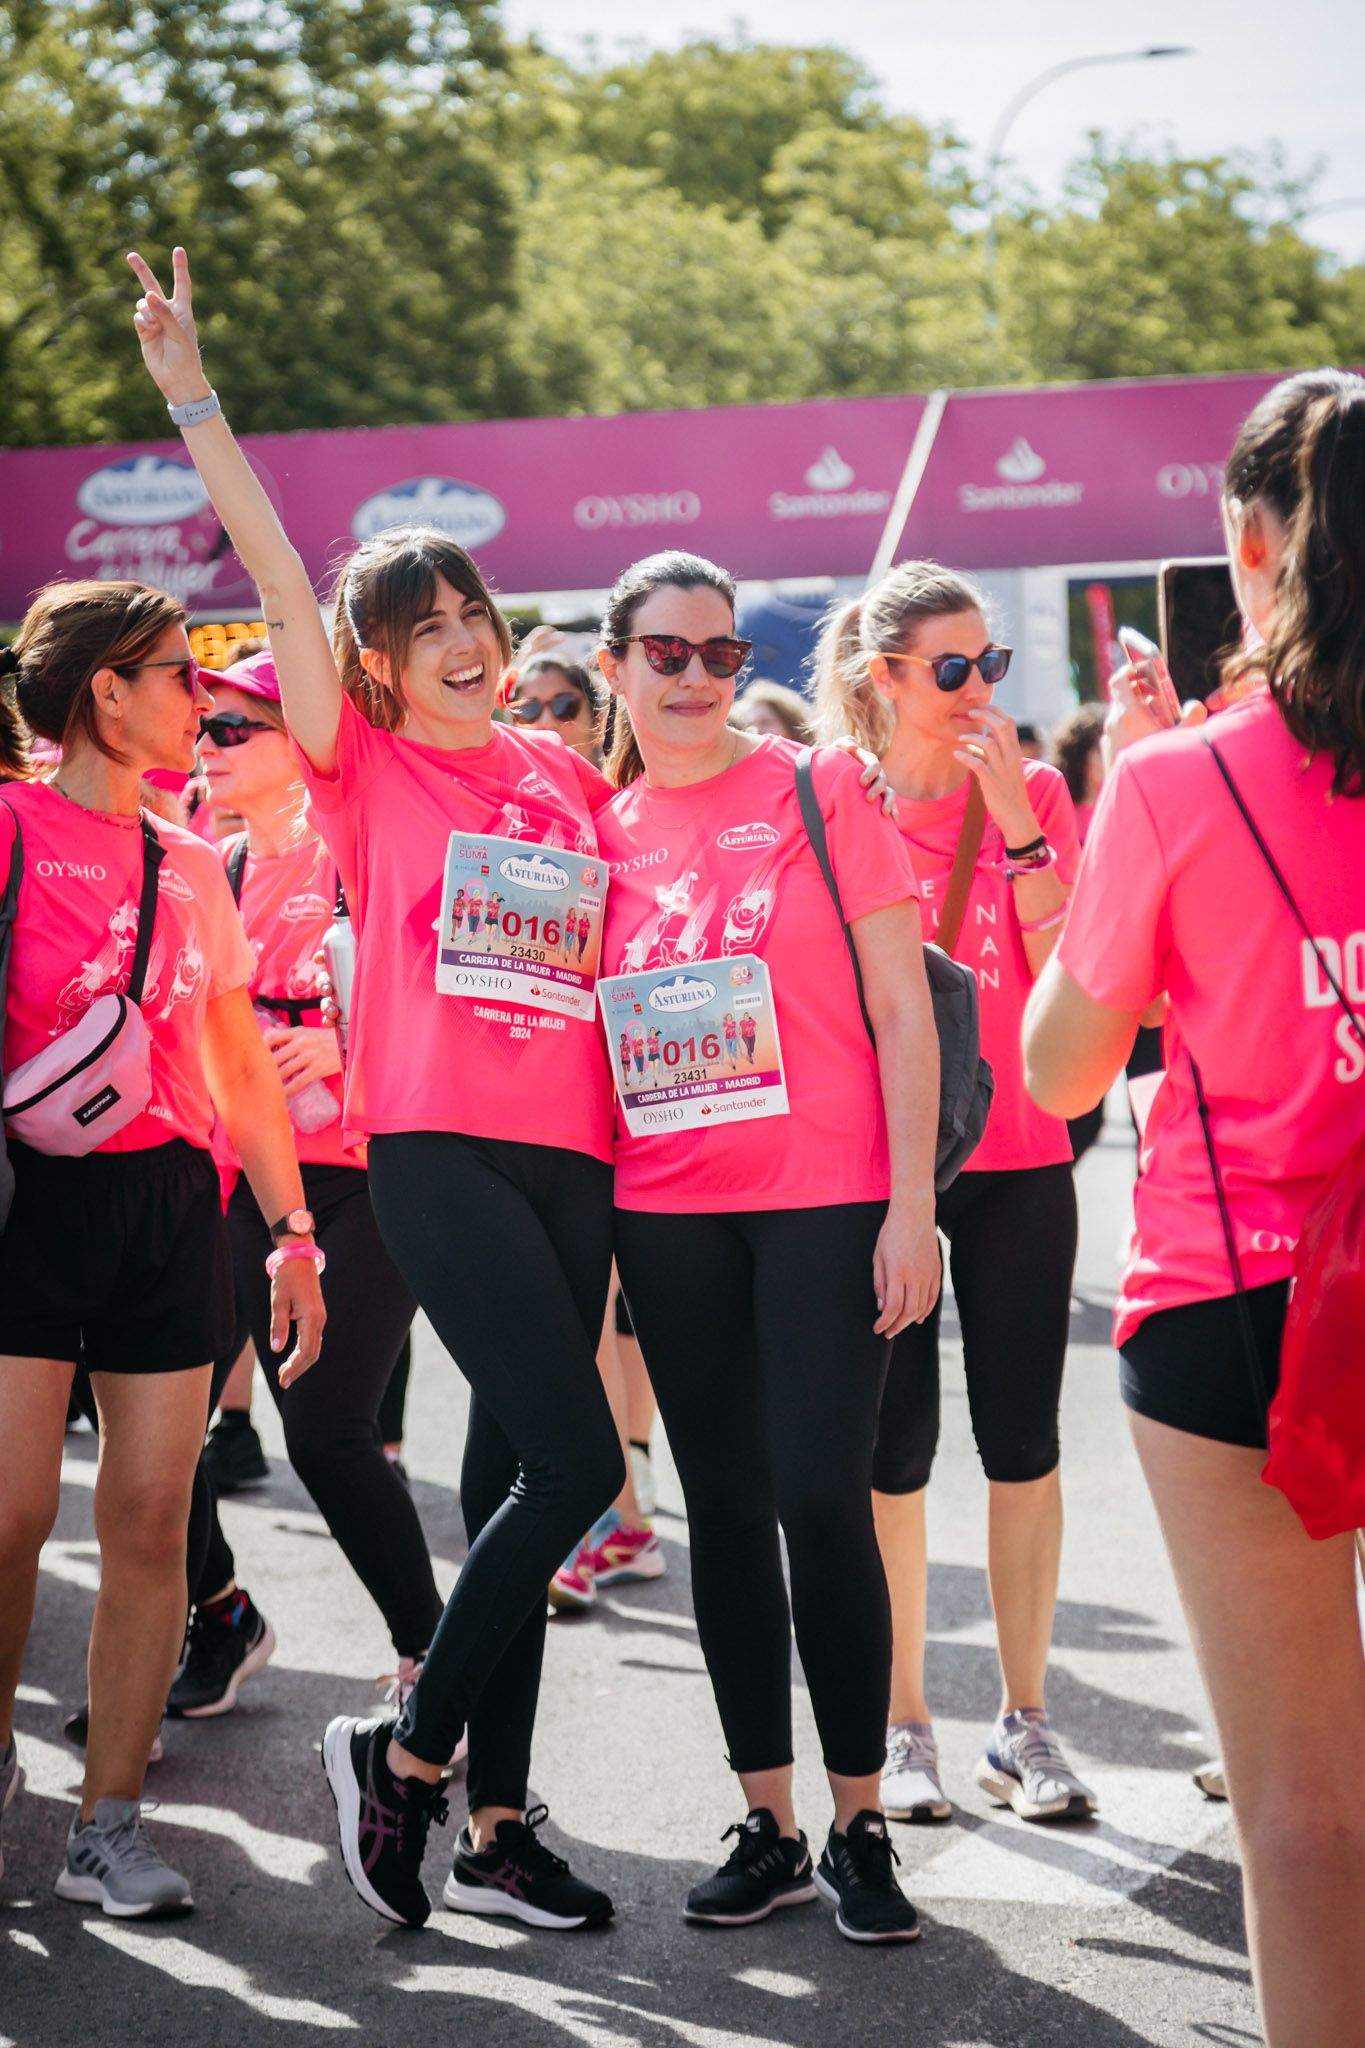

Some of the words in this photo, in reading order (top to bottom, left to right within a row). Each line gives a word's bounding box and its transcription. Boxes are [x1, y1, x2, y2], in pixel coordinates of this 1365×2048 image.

[769, 490, 891, 521] Santander
[958, 481, 1084, 513] Santander
[574, 490, 701, 531] OYSHO
[722, 834, 777, 847] ASTURIANA
[458, 849, 488, 862] SUMA
[608, 847, 669, 876] OYSHO
[36, 860, 107, 881] OYSHO
[504, 862, 566, 887] ASTURIANA
[502, 911, 561, 945] 016
[510, 945, 546, 962] 23430
[459, 953, 500, 967] CARRERA
[501, 958, 512, 969] DE
[514, 961, 524, 971] LA
[526, 964, 551, 977] MUJER
[555, 970, 583, 985] MADRID
[456, 972, 512, 991] OYSHO
[541, 987, 581, 1007] Santander
[611, 991, 637, 1003] SUMA
[654, 988, 712, 1008] ASTURIANA
[473, 1005, 512, 1025] CARRERA
[514, 1013, 526, 1026] DE
[527, 1015, 538, 1027] LA
[539, 1016, 566, 1031] MUJER
[509, 1027, 532, 1039] 2024
[662, 1033, 721, 1066] 016
[674, 1068, 707, 1085] 23431
[637, 1091, 668, 1104] CARRERA
[669, 1089, 678, 1099] DE
[679, 1087, 689, 1097] LA
[690, 1083, 718, 1096] MUJER
[725, 1075, 761, 1090] MADRID
[82, 1092, 113, 1119] EASTPAK
[713, 1096, 767, 1113] Santander
[643, 1107, 684, 1125] OYSHO
